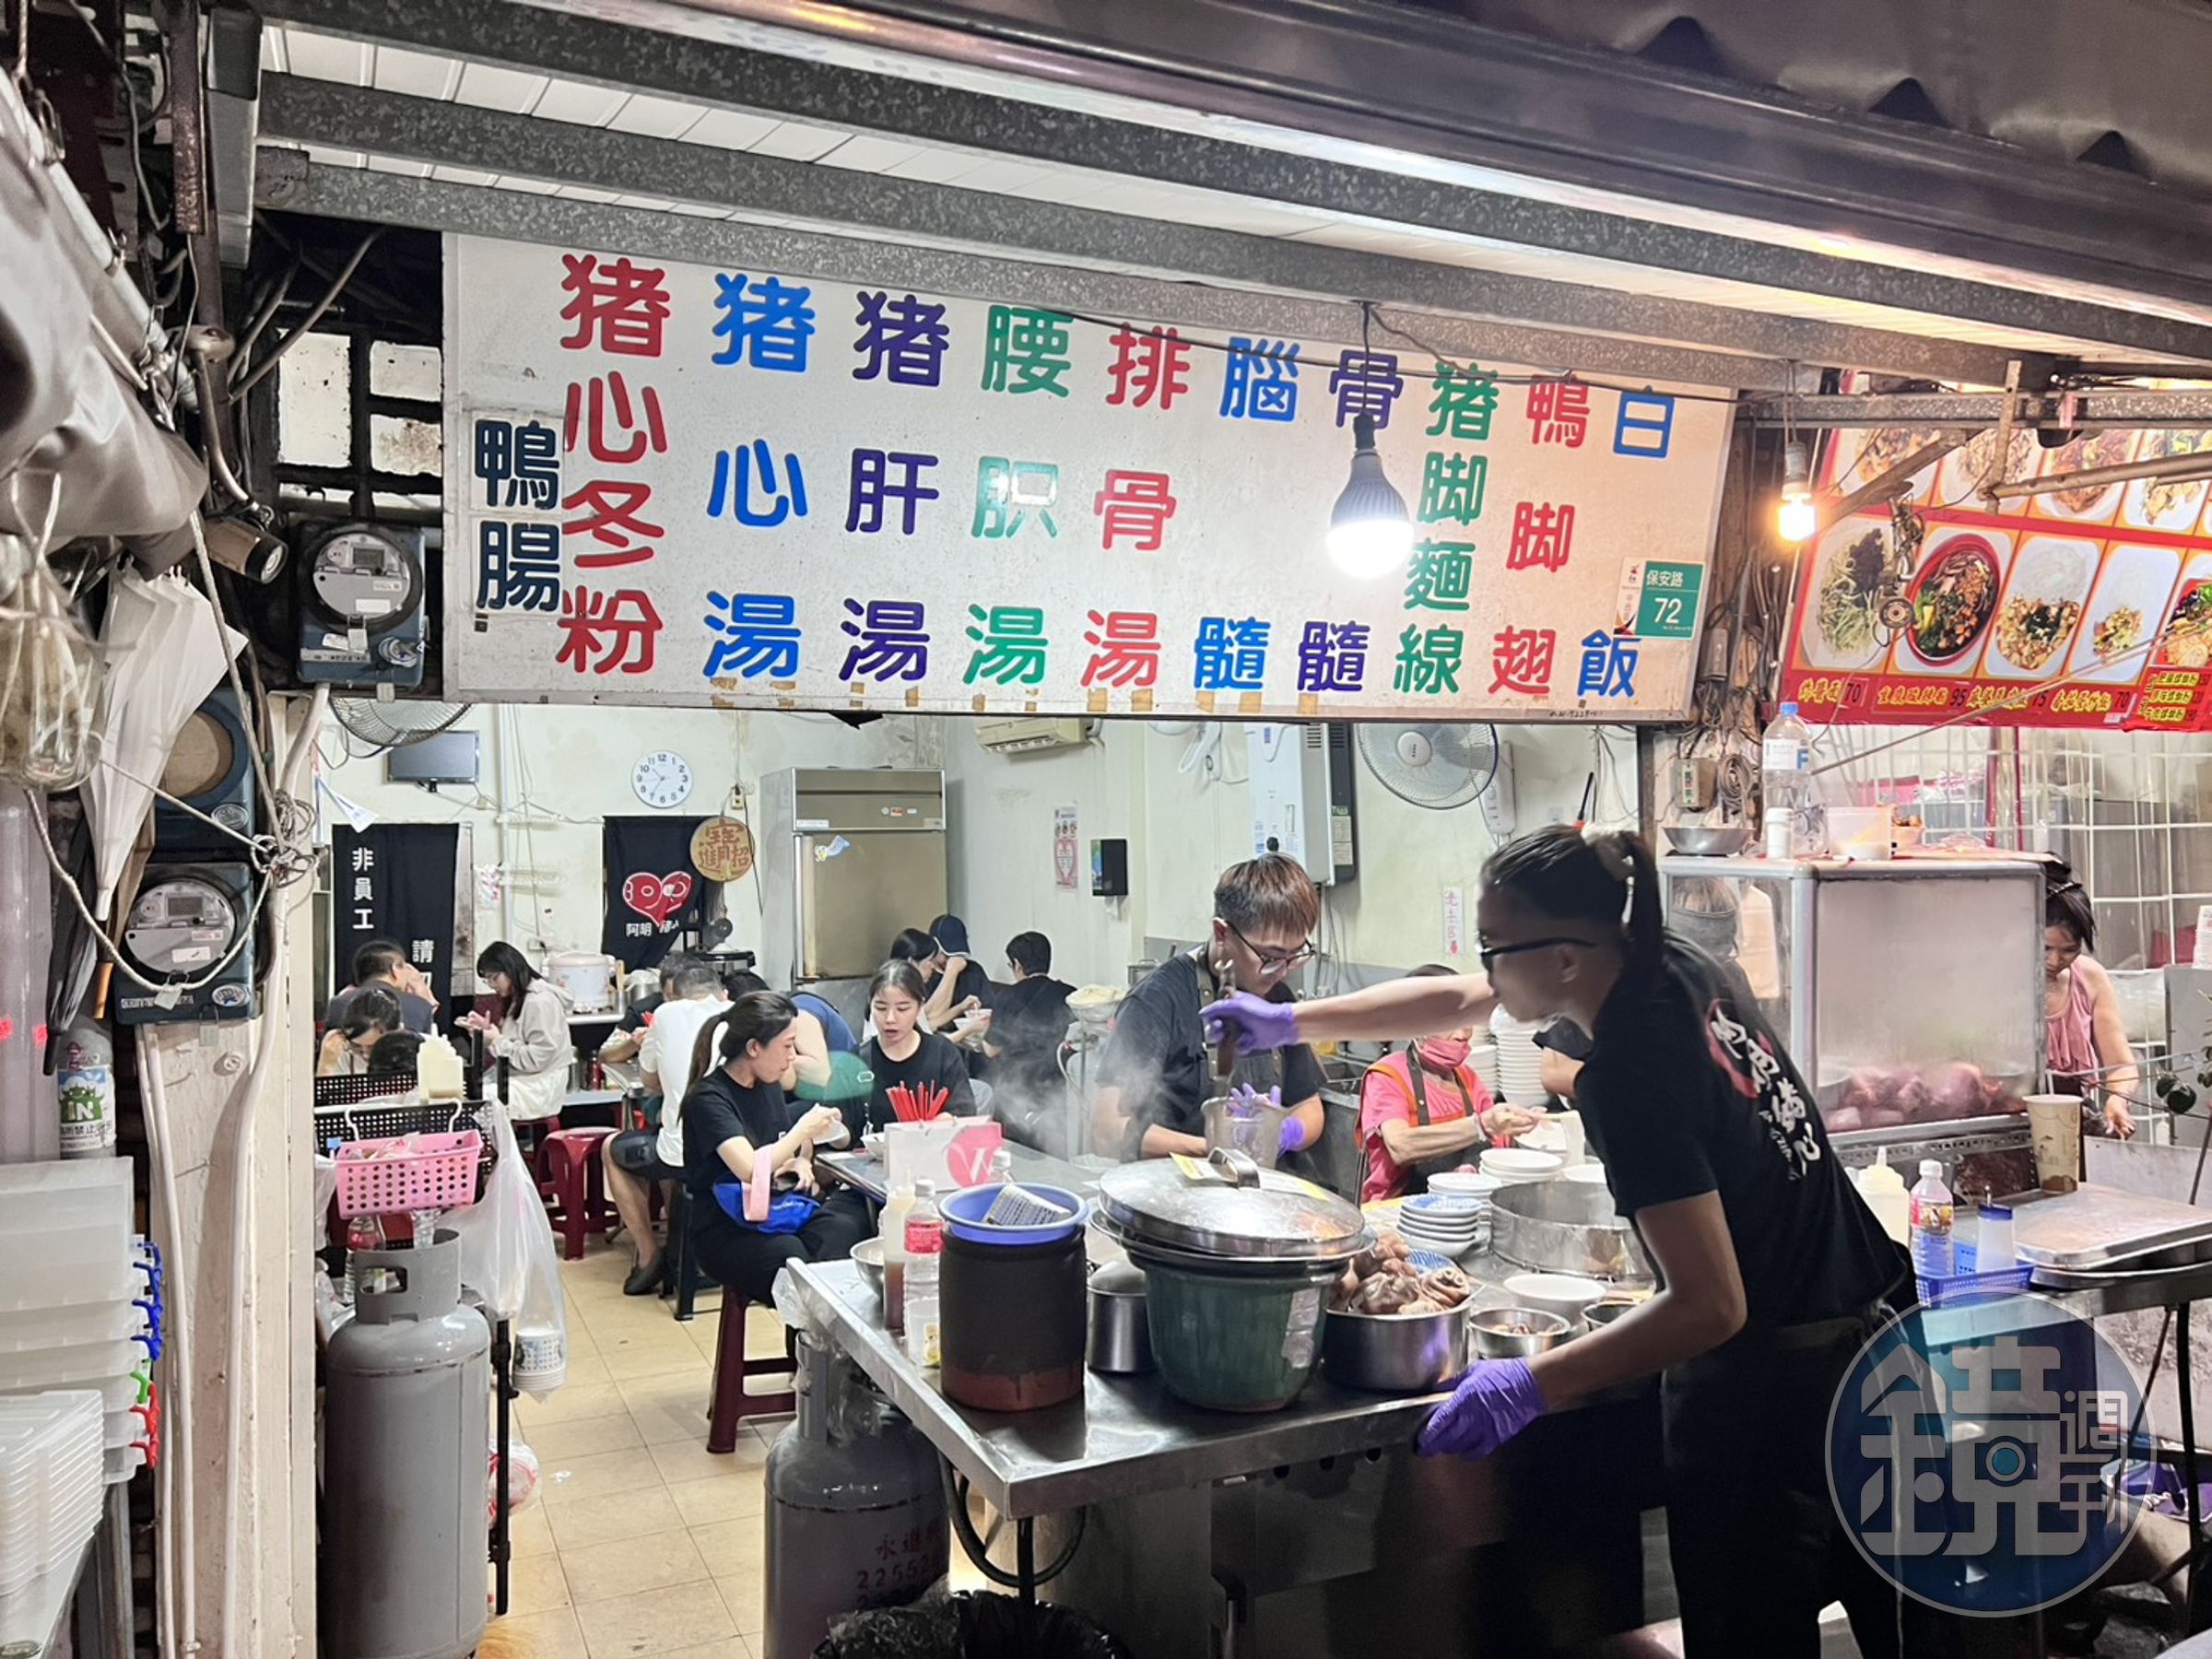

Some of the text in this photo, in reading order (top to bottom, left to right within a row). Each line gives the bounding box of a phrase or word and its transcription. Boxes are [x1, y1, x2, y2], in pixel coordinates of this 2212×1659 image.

[474, 418, 561, 612] 鴨腸
[554, 253, 671, 675] 猪心冬粉
[702, 273, 816, 678] 猪心湯
[838, 290, 950, 682] 猪肝湯
[1079, 322, 1192, 688] 排骨湯
[1194, 336, 1301, 691] 腦髓
[1577, 384, 1676, 699] 白飯
[1646, 569, 1684, 588] 保安路
[1653, 596, 1682, 624] 72
[1846, 681, 1862, 703] 70
[351, 846, 375, 930] 非員工
